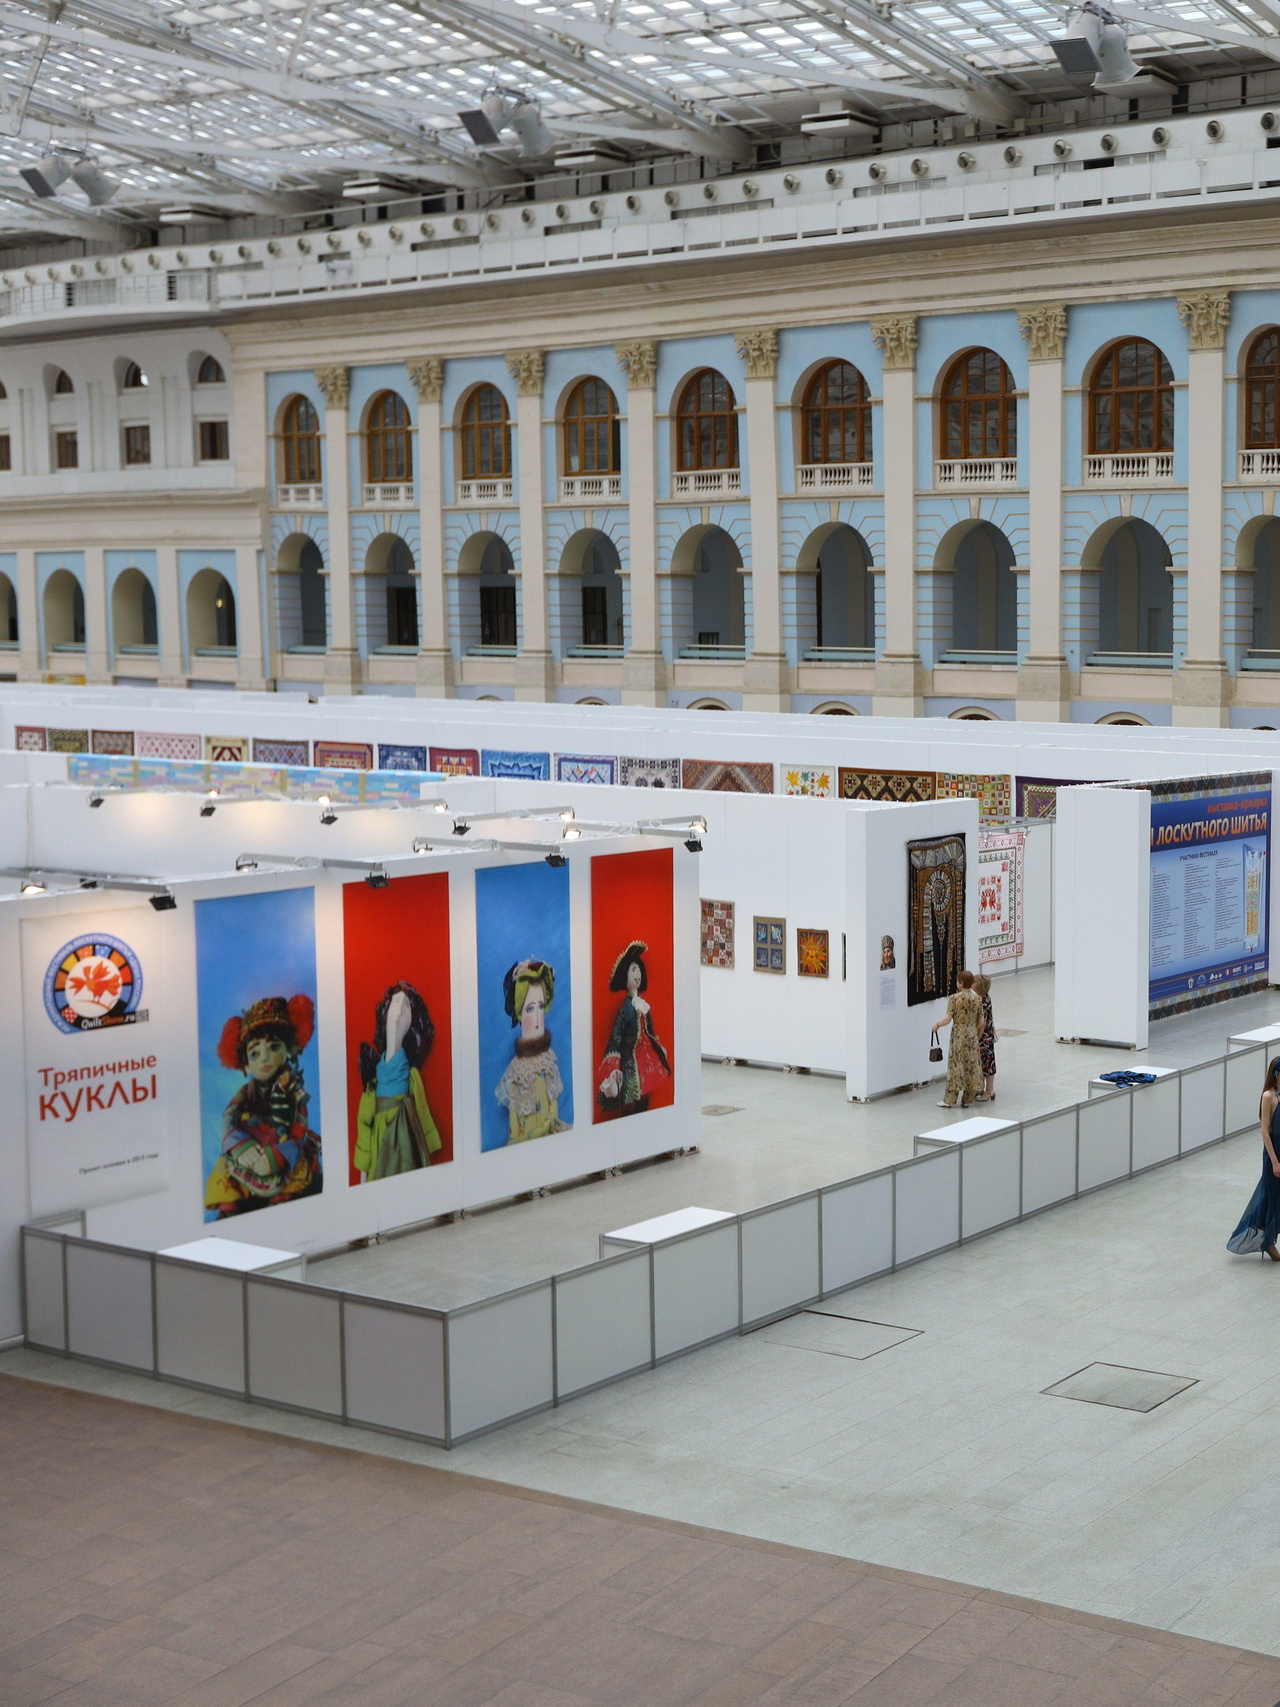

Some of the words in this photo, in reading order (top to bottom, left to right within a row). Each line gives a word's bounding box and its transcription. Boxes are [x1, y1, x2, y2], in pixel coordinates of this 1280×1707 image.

[1156, 817, 1229, 846] ЛОСКУТНОГО
[1231, 811, 1267, 835] ШИТЬЯ
[37, 1055, 157, 1090] Тряпичные
